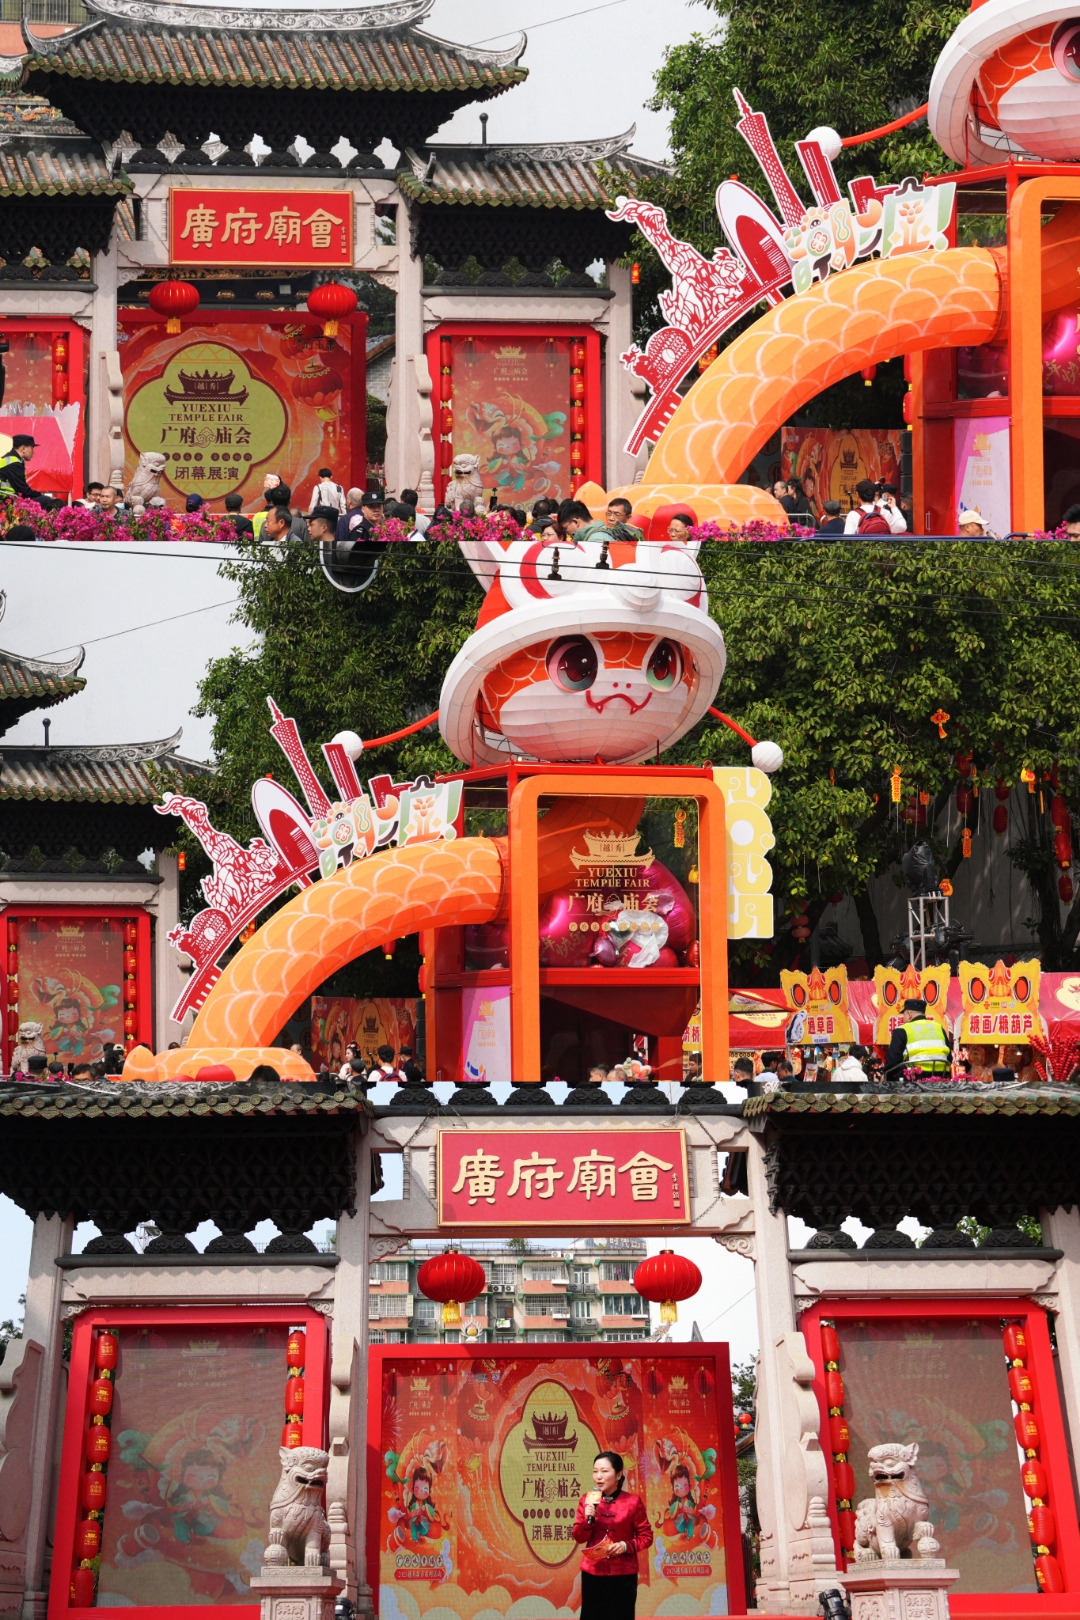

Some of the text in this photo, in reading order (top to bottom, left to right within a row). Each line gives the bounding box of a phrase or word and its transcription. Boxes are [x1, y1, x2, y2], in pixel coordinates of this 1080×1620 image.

[180, 203, 343, 248] 廣府廟會
[181, 403, 232, 413] YUEXIU
[169, 413, 244, 422] TEMPLE FAIR
[160, 426, 252, 445] 广府庙会
[174, 466, 239, 480] 闭幕展演
[603, 843, 622, 852] 越秀
[588, 867, 638, 878] YUEXIU
[575, 879, 651, 888] TEMPLE FAIR
[568, 892, 659, 913] 广府庙会
[969, 1013, 1033, 1035] 糖画/糖葫芦
[451, 1148, 674, 1205] 廣府廟會
[534, 1451, 567, 1461] YUEXIU
[527, 1462, 576, 1472] TEMPLE FAIR
[521, 1477, 582, 1499] 广府庙会
[531, 1524, 576, 1541] 闭幕展演
